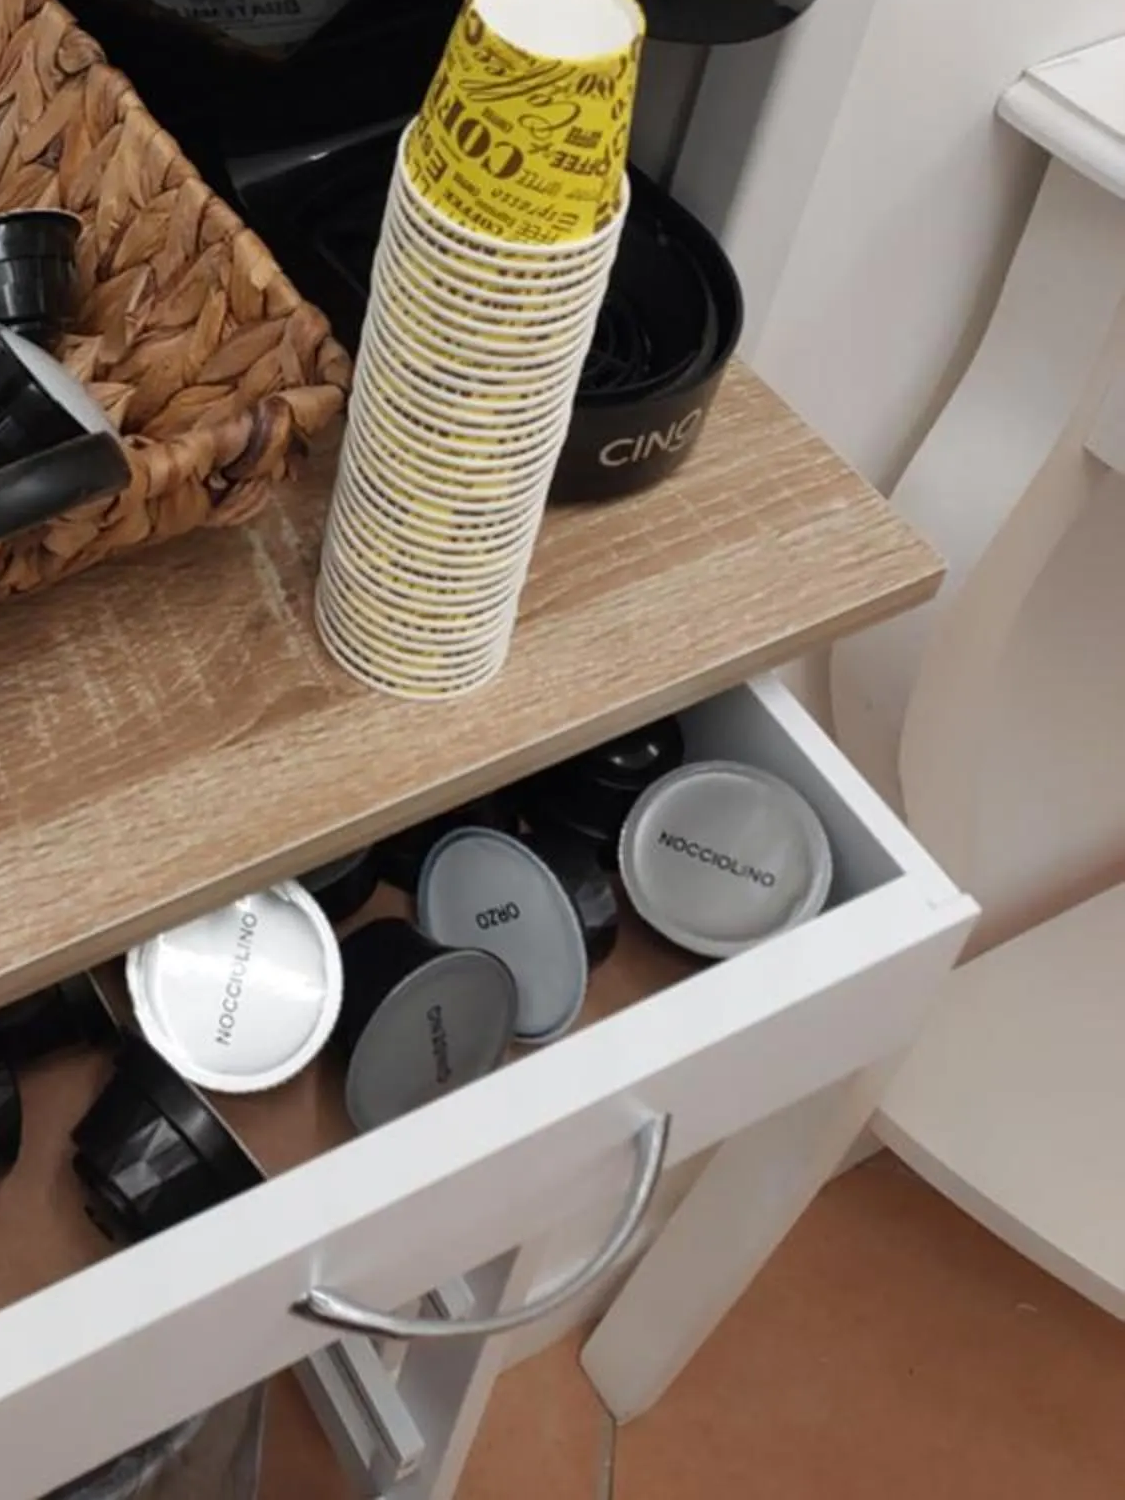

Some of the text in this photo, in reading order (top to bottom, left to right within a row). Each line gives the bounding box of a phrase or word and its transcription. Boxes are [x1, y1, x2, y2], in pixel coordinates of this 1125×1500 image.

[657, 829, 776, 888] NOCCIOLINO
[475, 901, 520, 931] ORZO
[215, 911, 259, 1046] NOCCIOLINO
